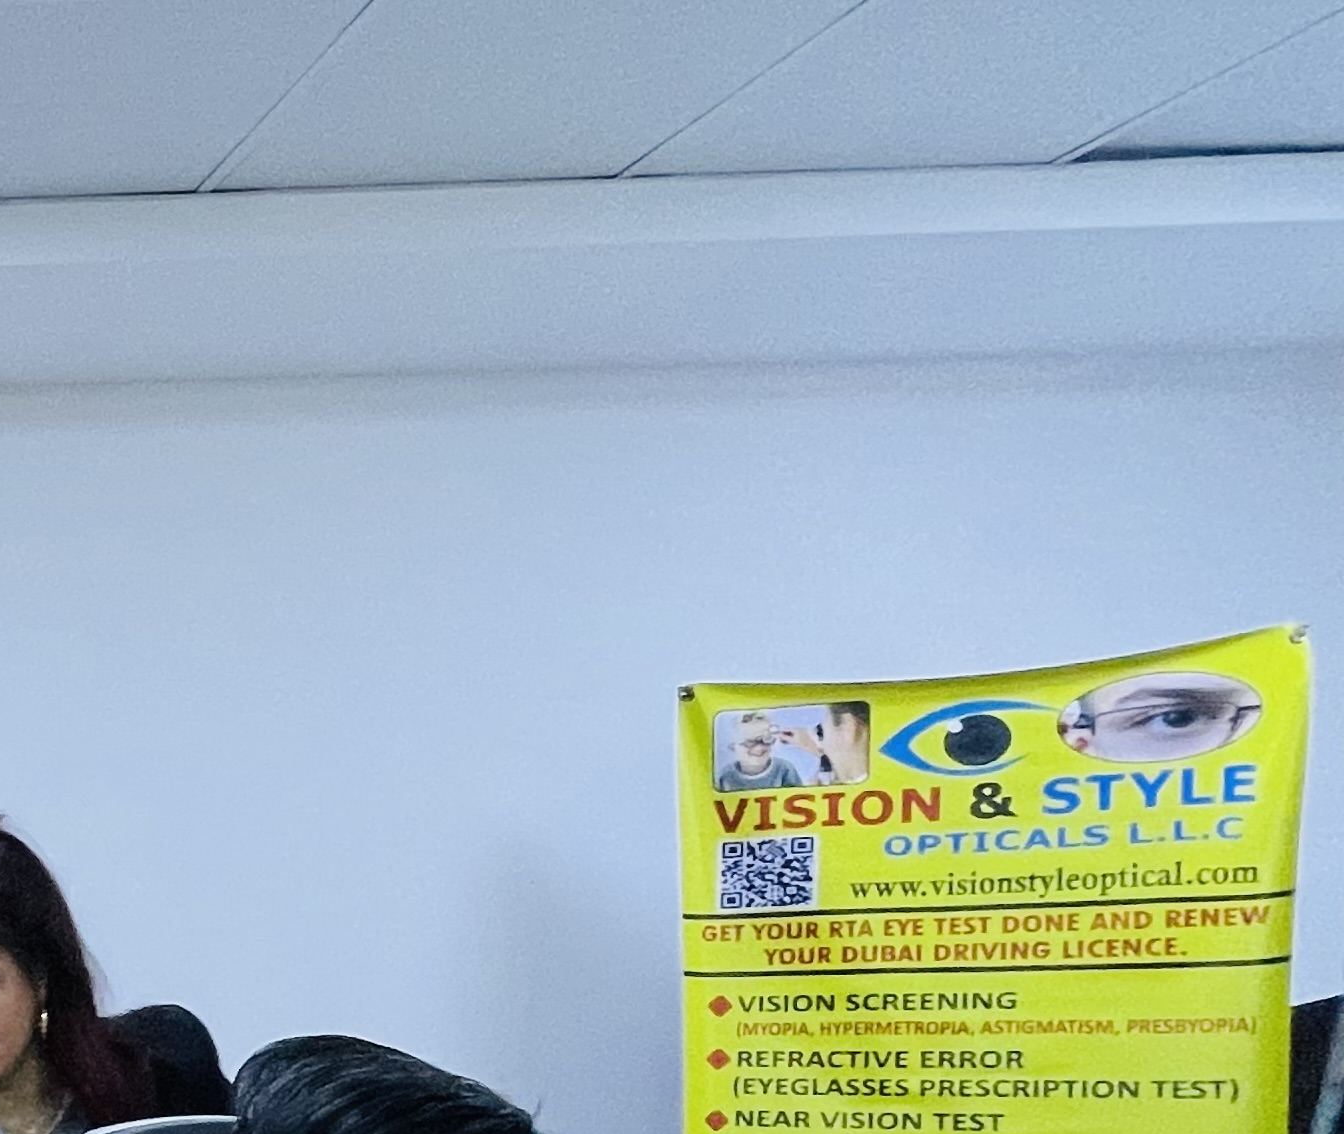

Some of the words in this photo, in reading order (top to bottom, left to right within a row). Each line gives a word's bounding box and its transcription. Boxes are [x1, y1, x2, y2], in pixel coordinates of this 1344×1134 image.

[714, 786, 942, 834] VISION
[970, 781, 1018, 819] &
[1042, 764, 1257, 815] STYLE
[884, 825, 1109, 857] OPTICALS
[1129, 816, 1244, 845] L.L.C
[850, 861, 1259, 899] www.visionstyleoptical.com
[702, 924, 745, 942] GET
[753, 920, 820, 941] YOUR
[829, 918, 873, 938] RTA
[884, 917, 923, 937] EYE
[933, 915, 990, 935] TEST
[1002, 912, 1079, 933] DONE
[1089, 908, 1156, 931] AND
[1165, 905, 1270, 929] RENEW
[764, 945, 831, 966] YOUR
[841, 943, 923, 964] DUBAI
[934, 940, 1050, 962] DRIVING
[1063, 937, 1188, 960] LICENCE.
[739, 994, 836, 1013] VISION
[846, 991, 1018, 1011] SCREENING
[737, 1020, 814, 1038] (MYOPIA,
[820, 1020, 974, 1037] HYPERMETROPIA,
[980, 1018, 1120, 1036] ASTIGMATISM,
[1127, 1017, 1257, 1036] PRESBYOPIA)
[737, 1050, 909, 1070] REFRACTIVE
[920, 1050, 1024, 1070] ERROR
[733, 1076, 909, 1099] (EYEGLASSES
[919, 1079, 1141, 1098] PRESCRIPTION
[1151, 1078, 1240, 1104] TEST)
[735, 1110, 811, 1128] NEAR
[821, 1112, 923, 1131] VISION
[933, 1113, 1004, 1132] TEST
